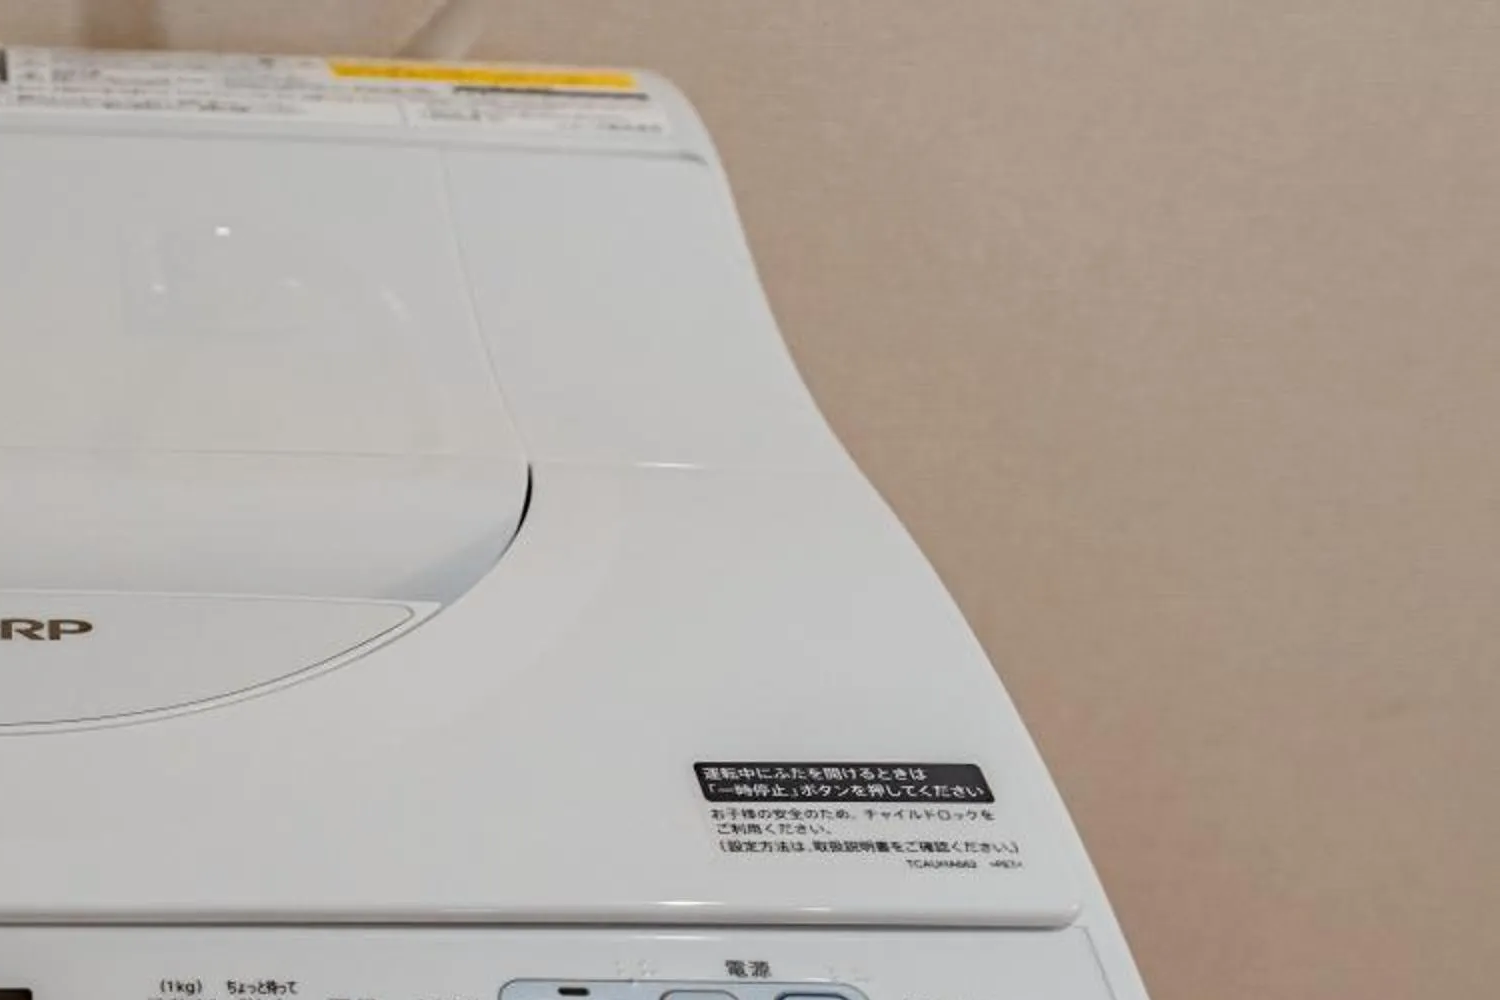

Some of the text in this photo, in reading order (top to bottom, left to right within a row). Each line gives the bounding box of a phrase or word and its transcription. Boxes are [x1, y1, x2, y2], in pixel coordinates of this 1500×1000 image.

[703, 767, 928, 782] 運転中にふたを開けるときは
[724, 959, 772, 979] 電源
[160, 979, 203, 997] (1kg)
[226, 979, 297, 996] ちょっと待って
